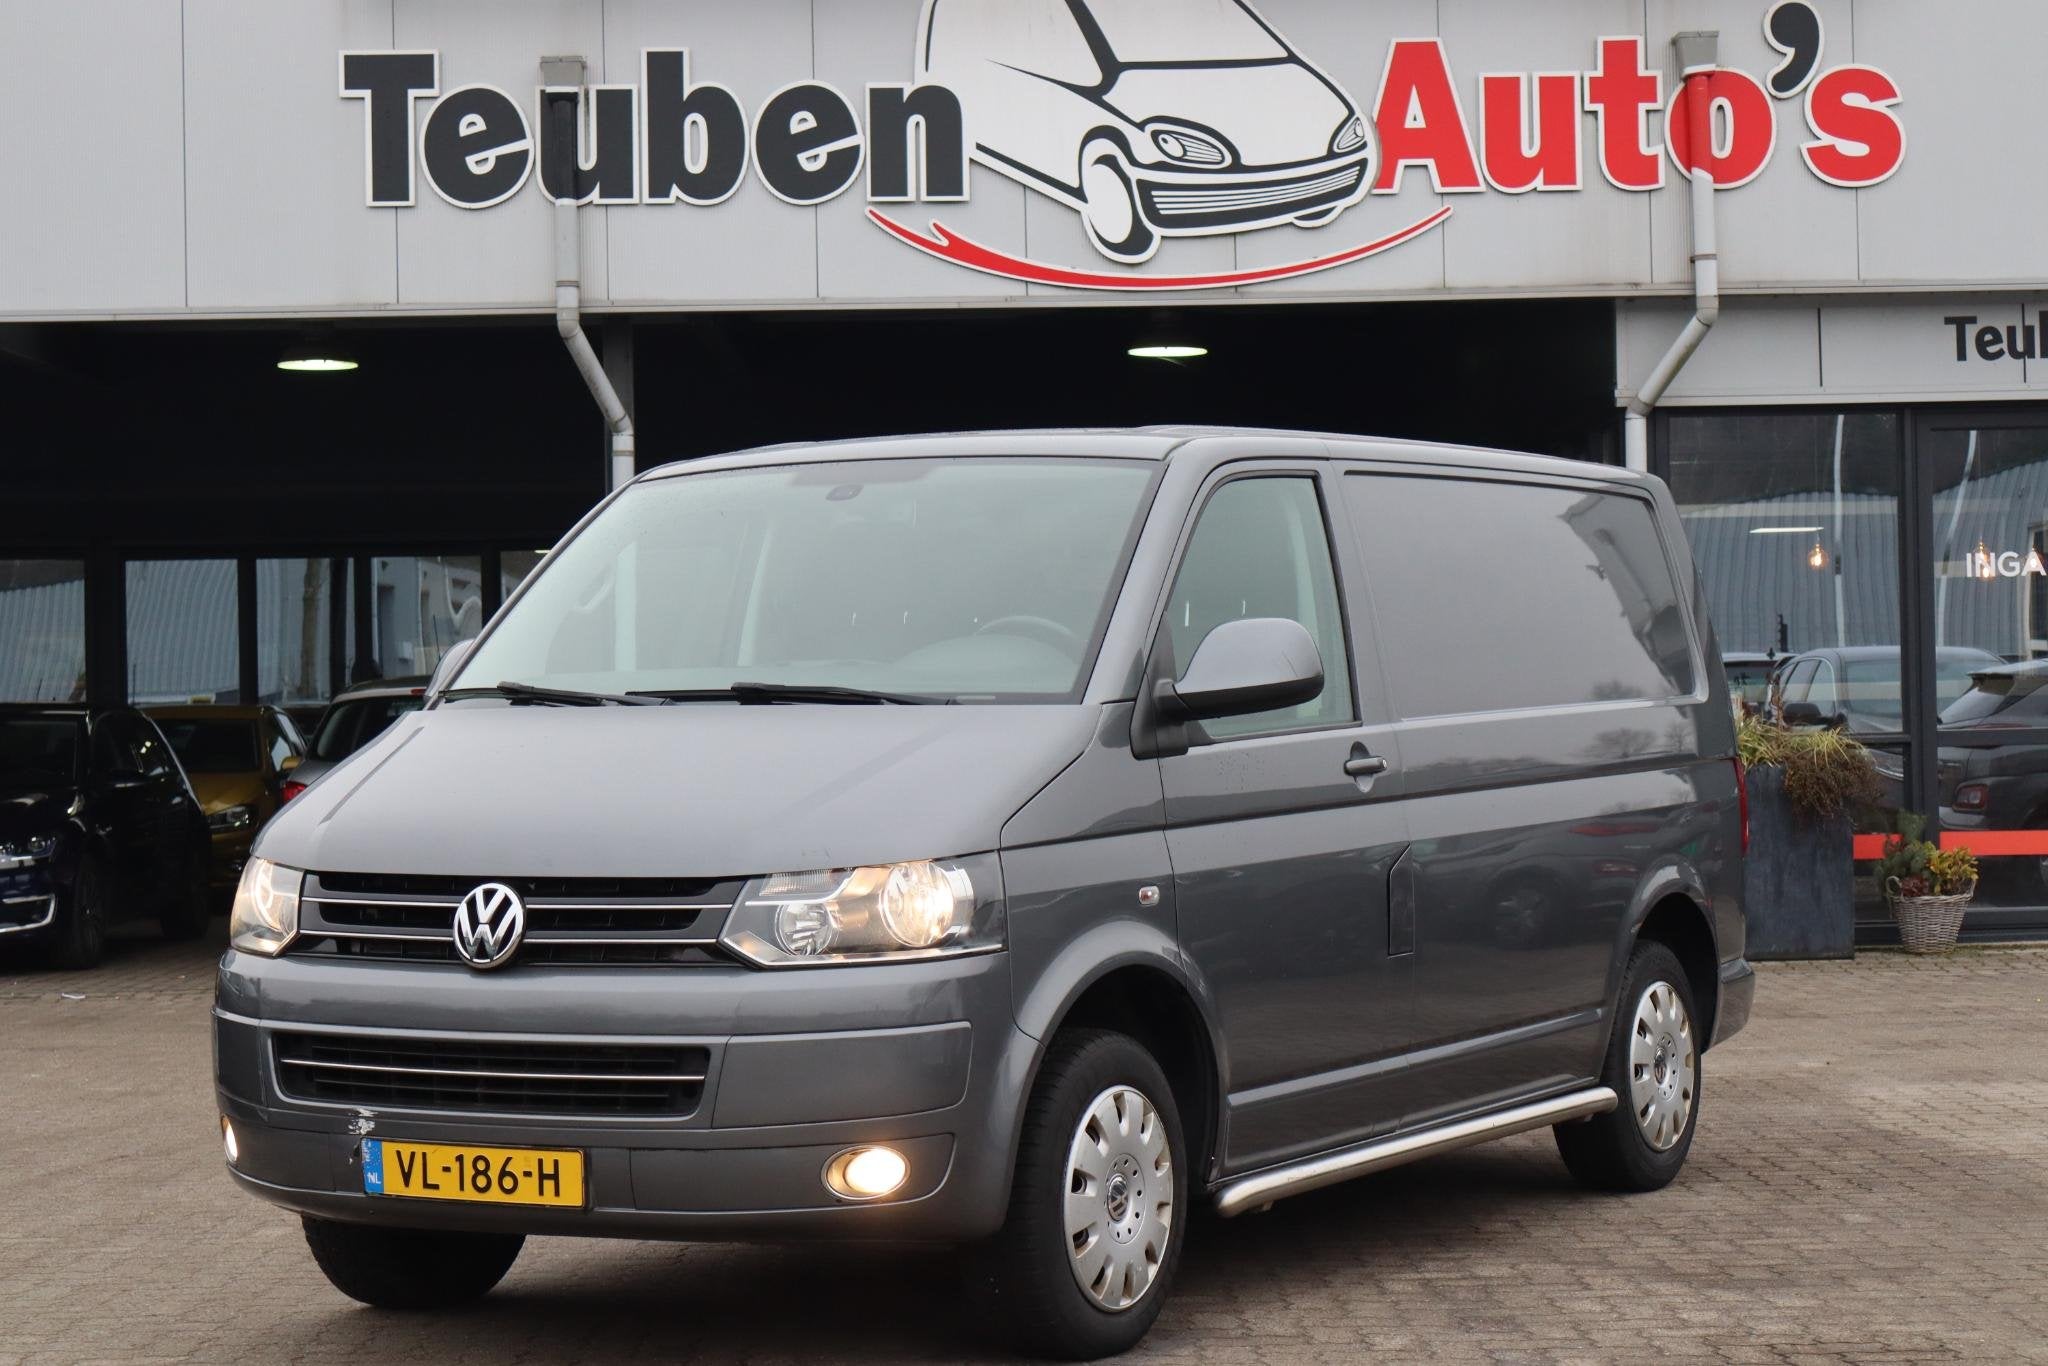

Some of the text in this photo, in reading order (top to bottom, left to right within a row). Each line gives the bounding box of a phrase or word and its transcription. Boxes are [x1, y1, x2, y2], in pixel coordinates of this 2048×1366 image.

[339, 0, 1907, 209] Teuben Auto's
[1966, 551, 2047, 577] INGA
[367, 1172, 381, 1185] NL
[395, 1149, 560, 1197] VL-186-H
